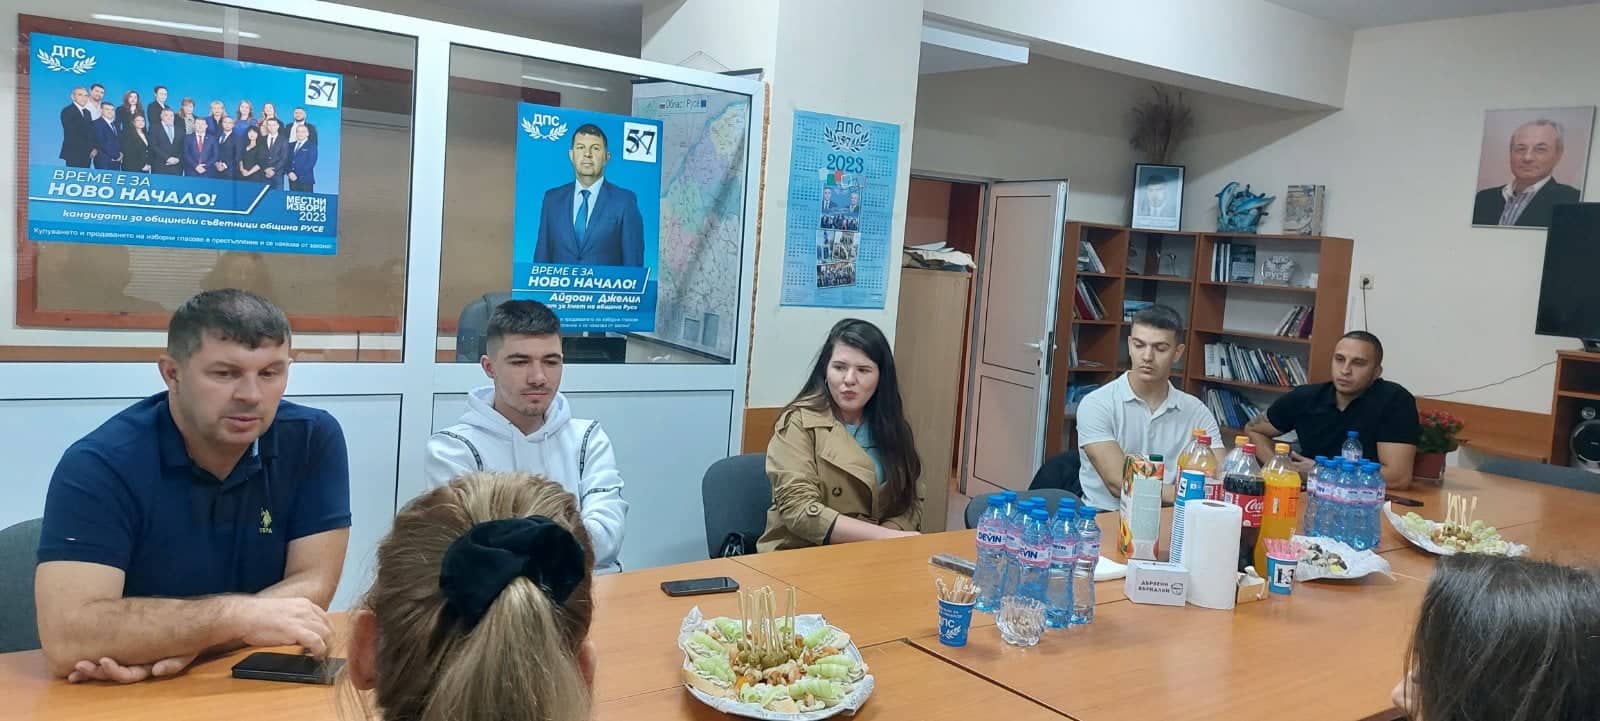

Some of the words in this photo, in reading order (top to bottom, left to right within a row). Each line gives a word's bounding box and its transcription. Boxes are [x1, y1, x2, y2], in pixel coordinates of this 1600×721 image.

[51, 44, 87, 59] ДПС
[533, 113, 560, 127] ДПС
[834, 120, 863, 135] ДПС
[826, 153, 865, 174] 2023
[53, 169, 113, 184] ВРЕМЕ
[116, 174, 128, 185] Е
[129, 175, 151, 187] ЗА
[47, 182, 115, 200] НОВО
[119, 187, 217, 206] НАЧАЛО!
[286, 195, 327, 206] МЕСТНИ
[286, 203, 327, 213] ИЗБОРИ
[62, 209, 128, 221] кандидати
[129, 215, 143, 223] за
[144, 215, 199, 226] общински
[200, 217, 258, 230] съветници
[259, 222, 299, 232] община
[300, 224, 325, 233] РУСЕ
[298, 212, 327, 222] 2023
[531, 265, 569, 277] ВРЕМЕ
[571, 267, 579, 277] Е
[580, 267, 594, 277] ЗА
[1264, 270, 1289, 281] РУСЕ
[528, 275, 571, 288] НОВО
[573, 278, 638, 291] НАЧАЛО!
[549, 291, 594, 304] Айдоан
[597, 293, 641, 305] Джелил
[978, 532, 1002, 543] DEVIN
